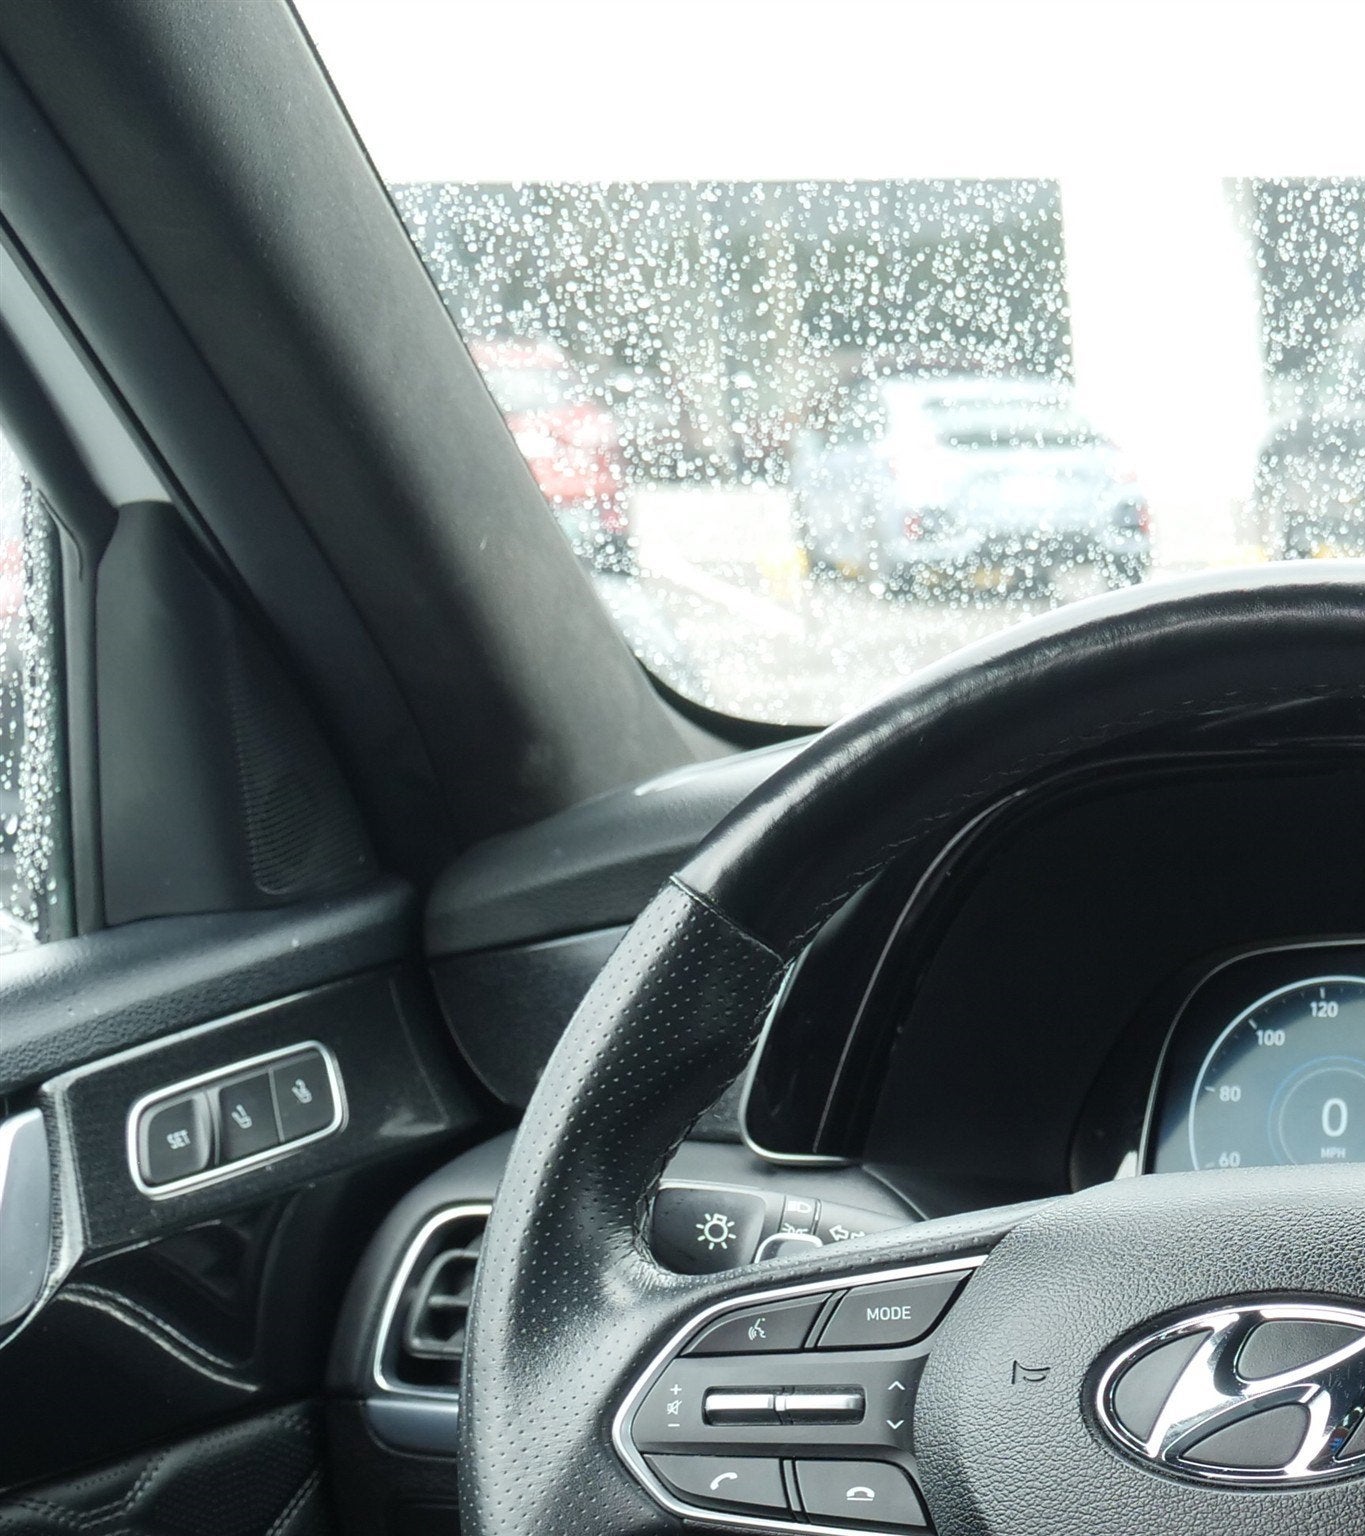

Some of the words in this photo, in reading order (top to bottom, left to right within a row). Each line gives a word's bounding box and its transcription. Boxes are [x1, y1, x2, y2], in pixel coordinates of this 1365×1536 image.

[1309, 1001, 1338, 1018] 120
[1256, 1029, 1285, 1046] 100
[1219, 1085, 1241, 1102] 80
[1321, 1097, 1348, 1138] 0
[166, 1129, 191, 1149] SET
[1218, 1151, 1240, 1168] 60
[1320, 1147, 1346, 1159] MPH
[866, 1305, 912, 1322] MODE
